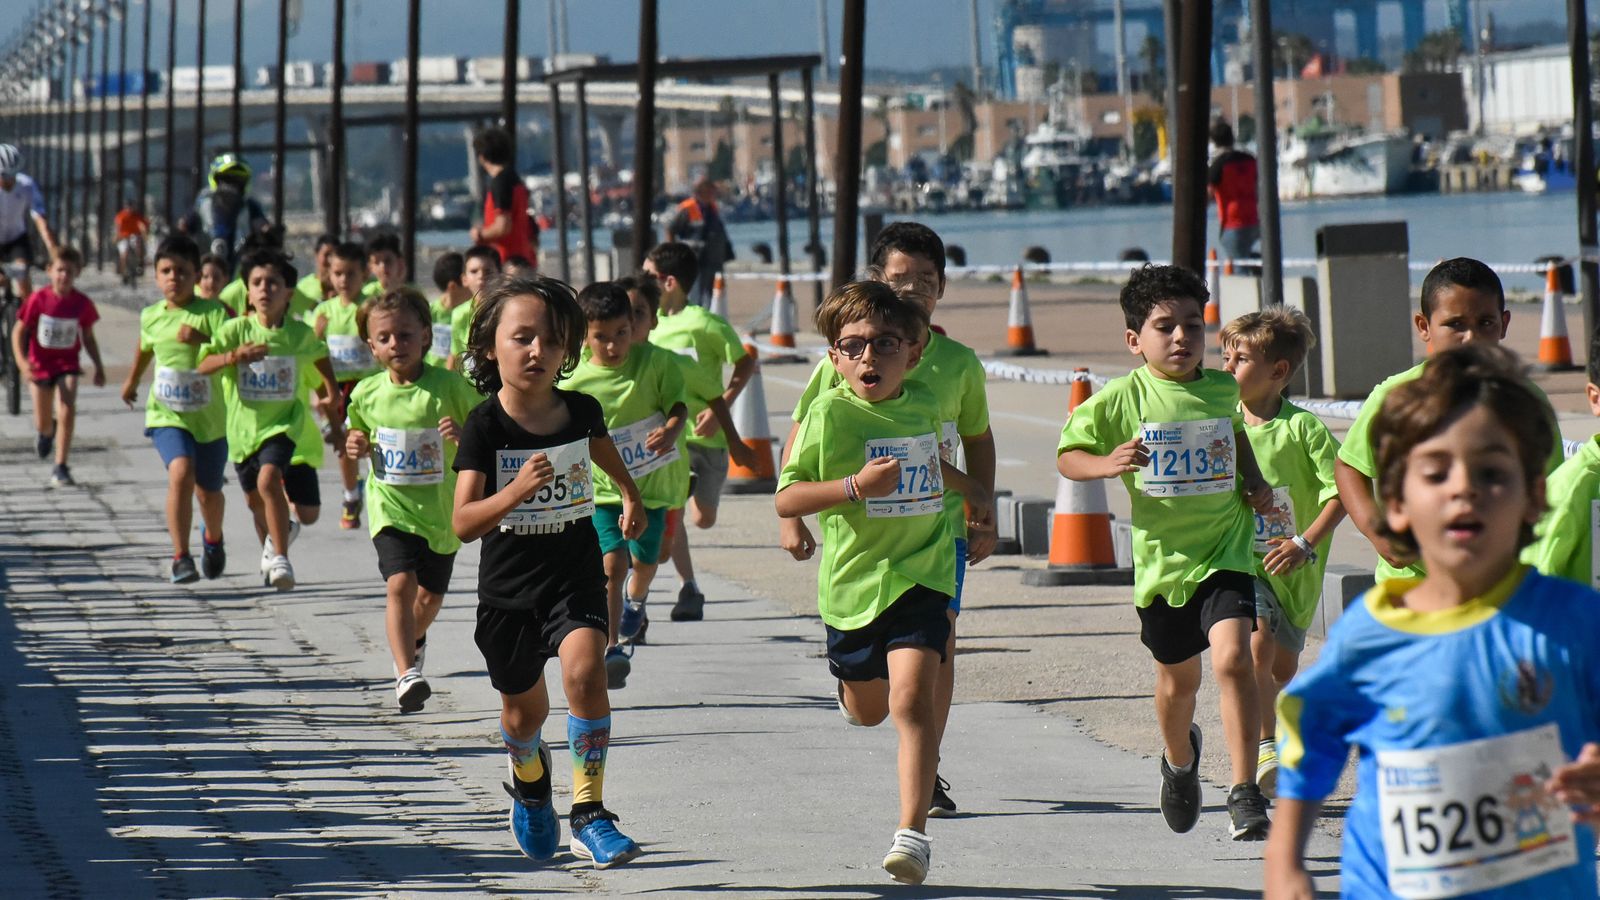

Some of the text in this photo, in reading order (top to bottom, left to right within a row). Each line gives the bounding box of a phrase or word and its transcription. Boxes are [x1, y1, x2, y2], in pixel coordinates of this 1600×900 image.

[1145, 430, 1162, 441] XXI
[378, 448, 417, 469] 1024
[870, 446, 888, 458] XXI
[501, 457, 520, 468] XXI
[1149, 448, 1208, 476] 1213
[1392, 795, 1503, 856] 1526
